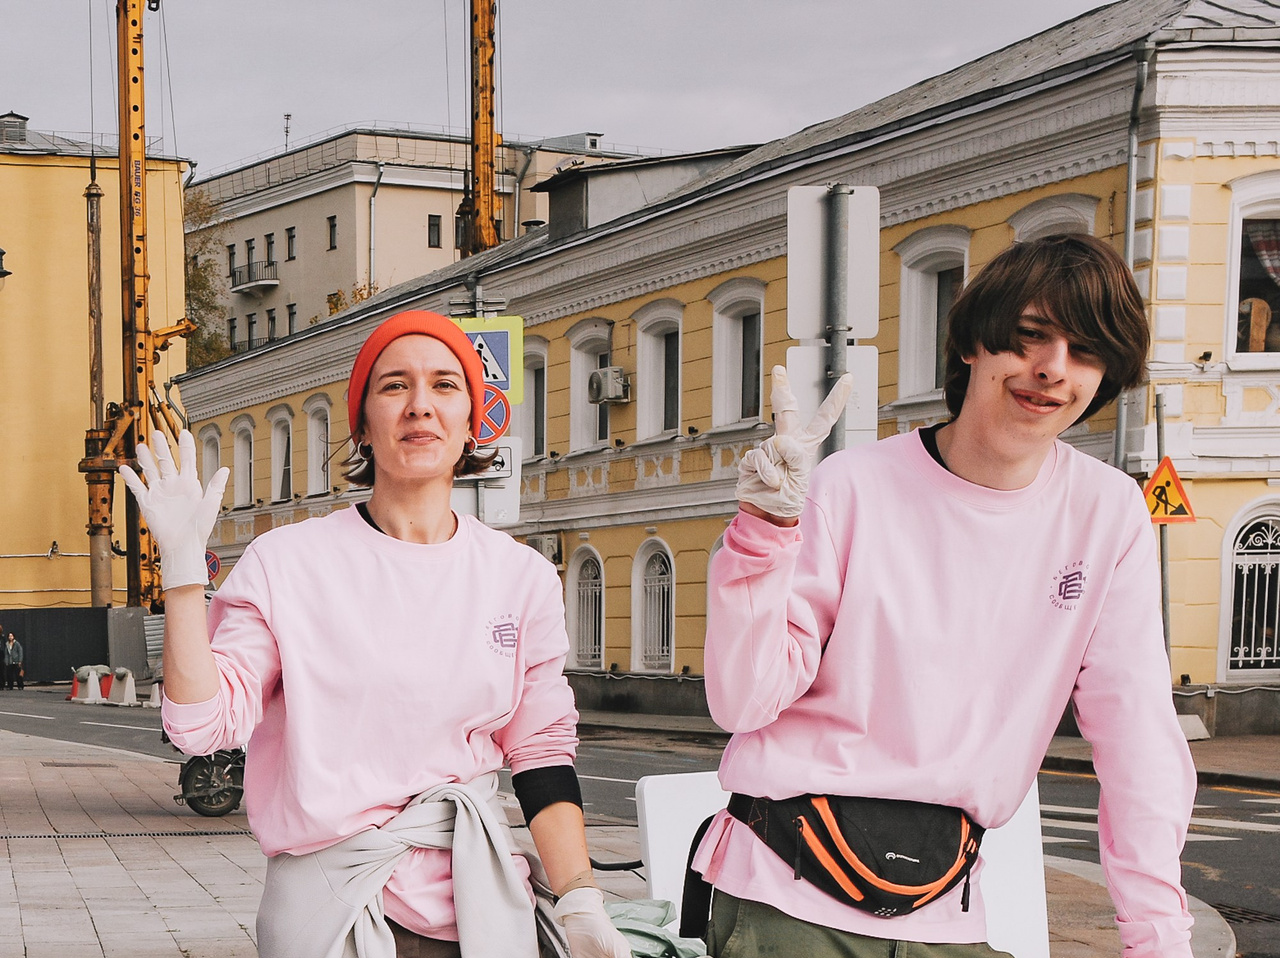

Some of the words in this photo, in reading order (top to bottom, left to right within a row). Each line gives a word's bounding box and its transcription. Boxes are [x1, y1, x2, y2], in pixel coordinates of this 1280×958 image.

[134, 160, 142, 188] BAUER
[1052, 560, 1090, 581] БЕГОВО
[485, 613, 519, 630] БЕГОВО
